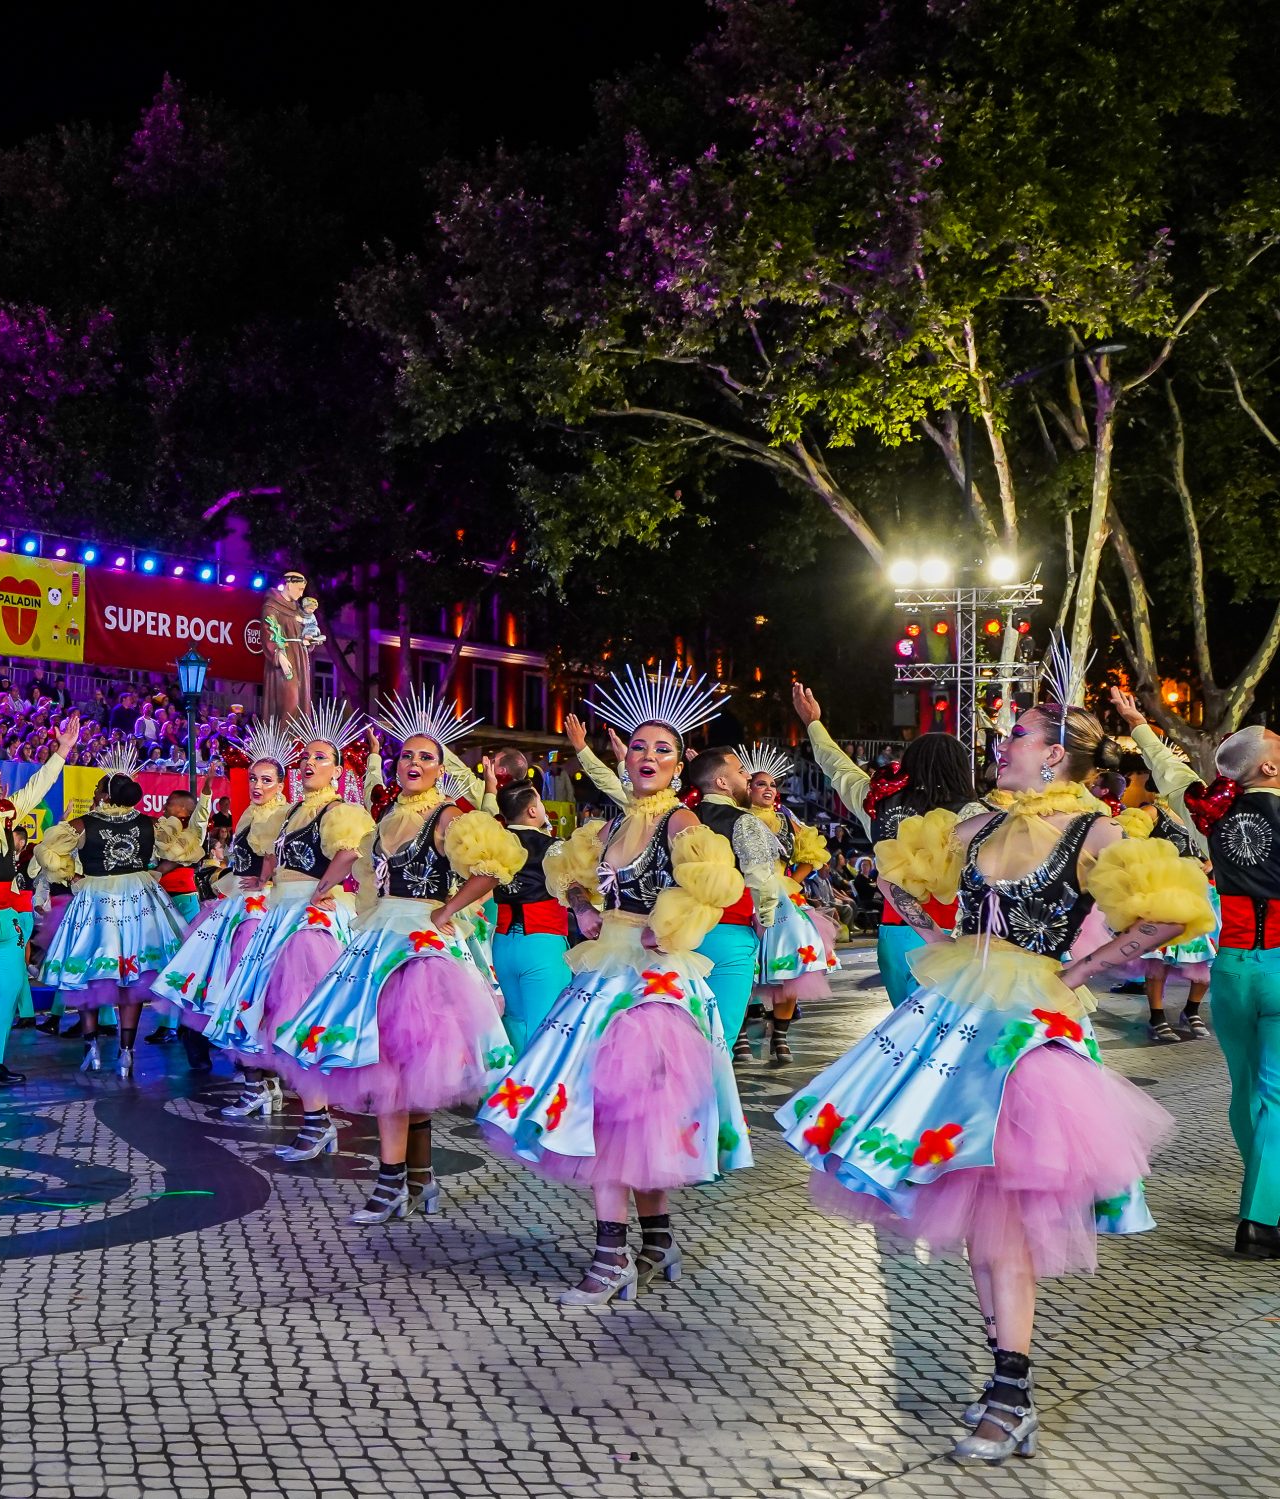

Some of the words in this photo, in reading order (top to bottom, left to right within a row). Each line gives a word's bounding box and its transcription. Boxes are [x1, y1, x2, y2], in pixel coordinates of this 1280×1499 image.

[104, 605, 171, 638] SUPER
[176, 615, 234, 645] BOCK
[247, 628, 261, 637] SUP
[248, 636, 262, 645] BOC
